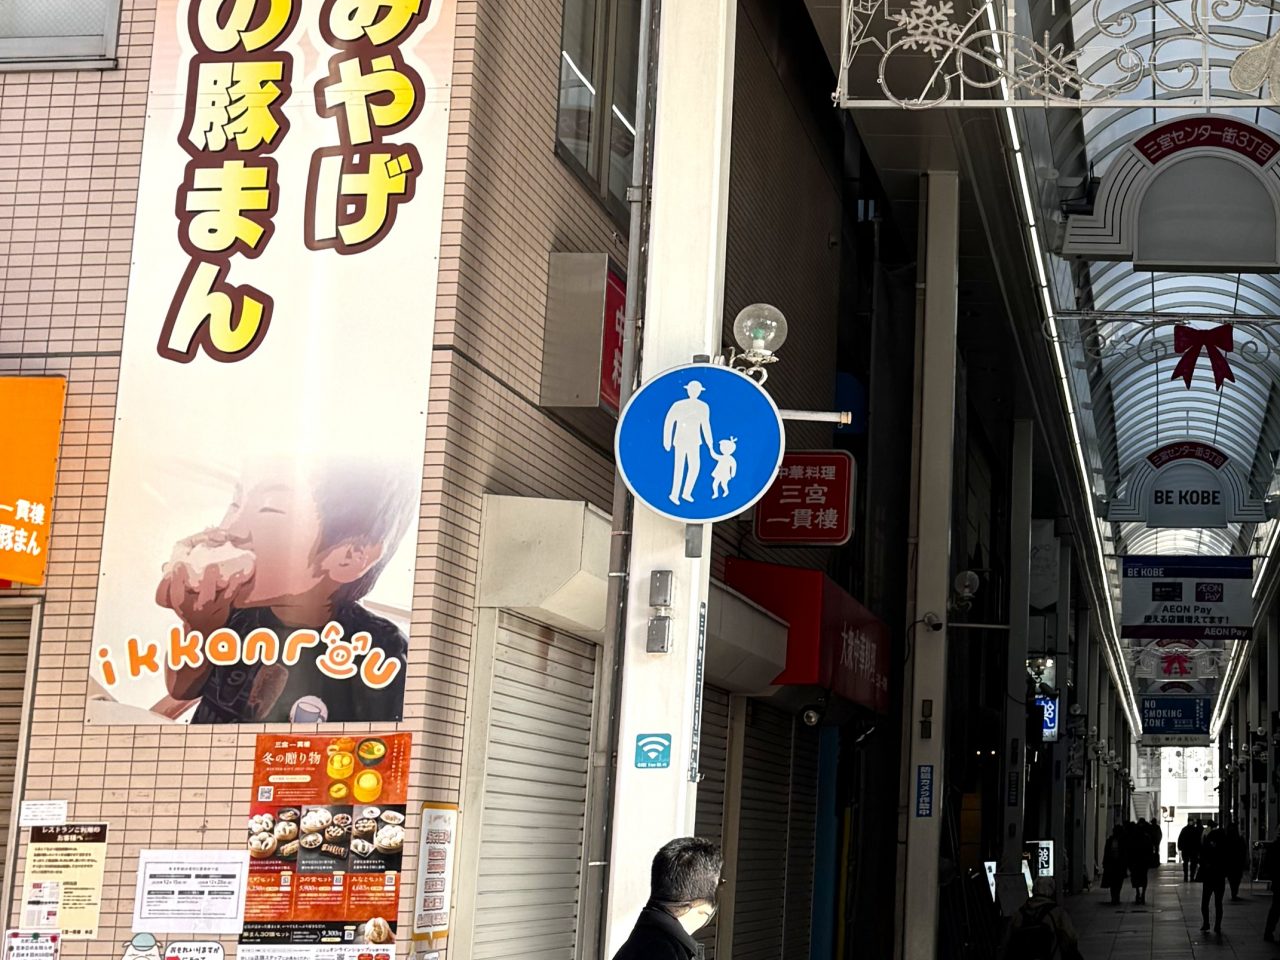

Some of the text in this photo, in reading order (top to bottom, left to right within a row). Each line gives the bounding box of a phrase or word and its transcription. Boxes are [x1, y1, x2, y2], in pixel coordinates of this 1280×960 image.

[1143, 124, 1275, 161] 三宮センター街3丁目
[779, 483, 829, 505] 三宮
[1154, 490, 1221, 505] BE KOBE
[1127, 567, 1165, 577] BE KOBE
[1162, 605, 1212, 615] AEON Pay
[1203, 627, 1248, 637] AEON Pay
[1144, 699, 1156, 708] NO
[1143, 709, 1183, 718] SMOKING
